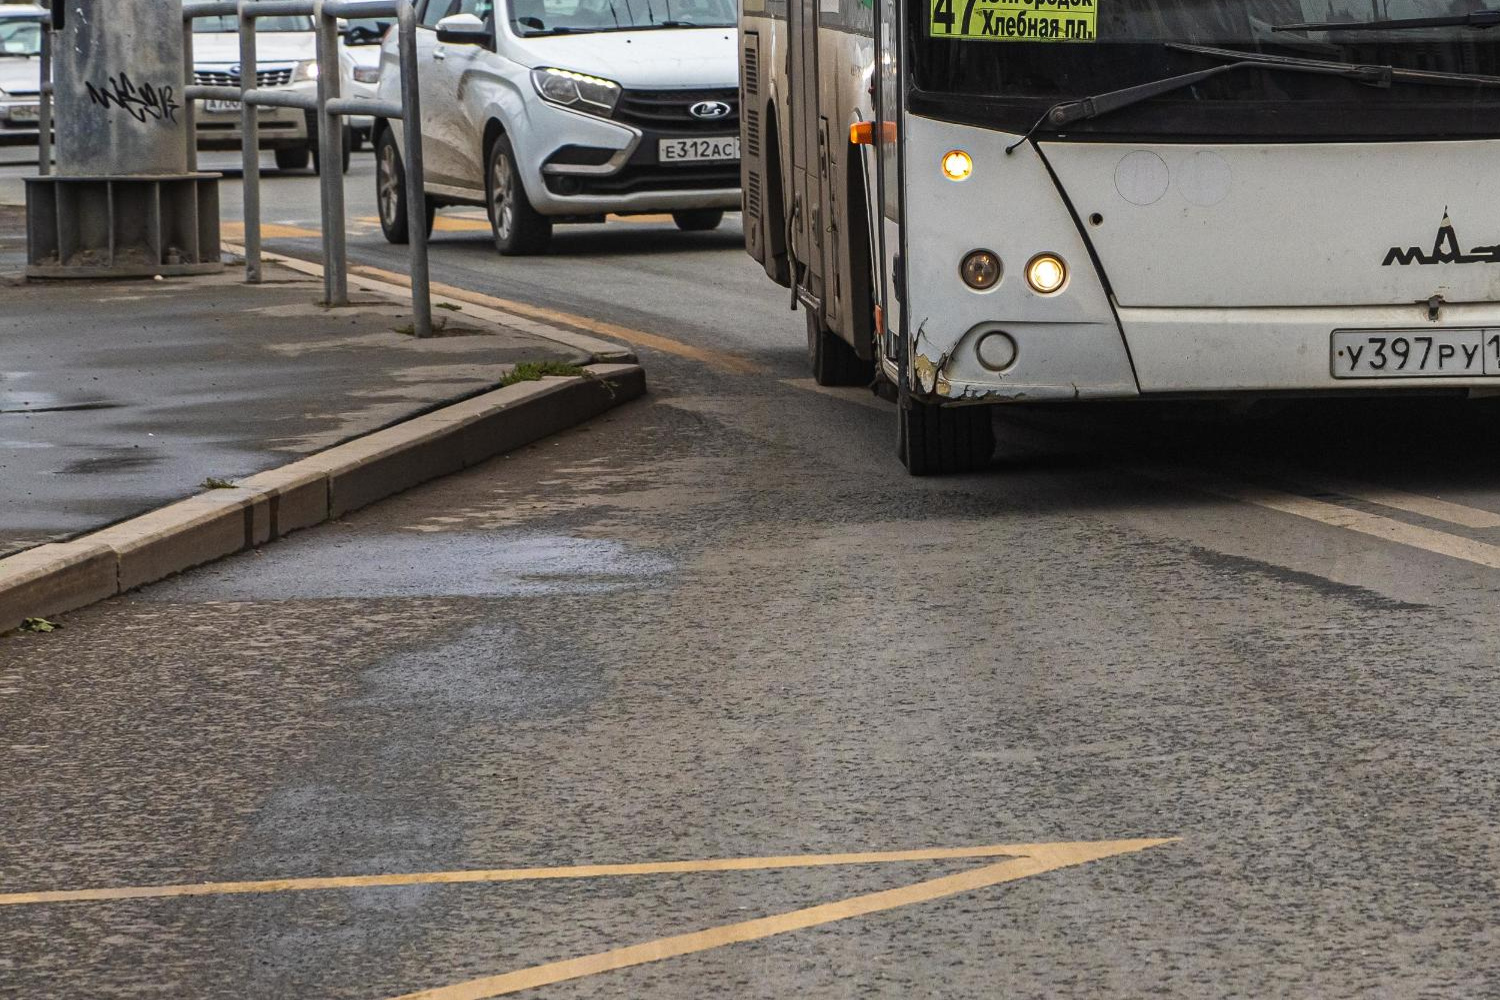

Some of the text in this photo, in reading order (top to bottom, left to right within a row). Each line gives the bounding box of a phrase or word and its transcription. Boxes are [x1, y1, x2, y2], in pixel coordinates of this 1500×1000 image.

[981, 10, 1093, 40] Хлебная пл.
[665, 140, 733, 159] Е312АС
[1346, 337, 1479, 371] У397РУ
